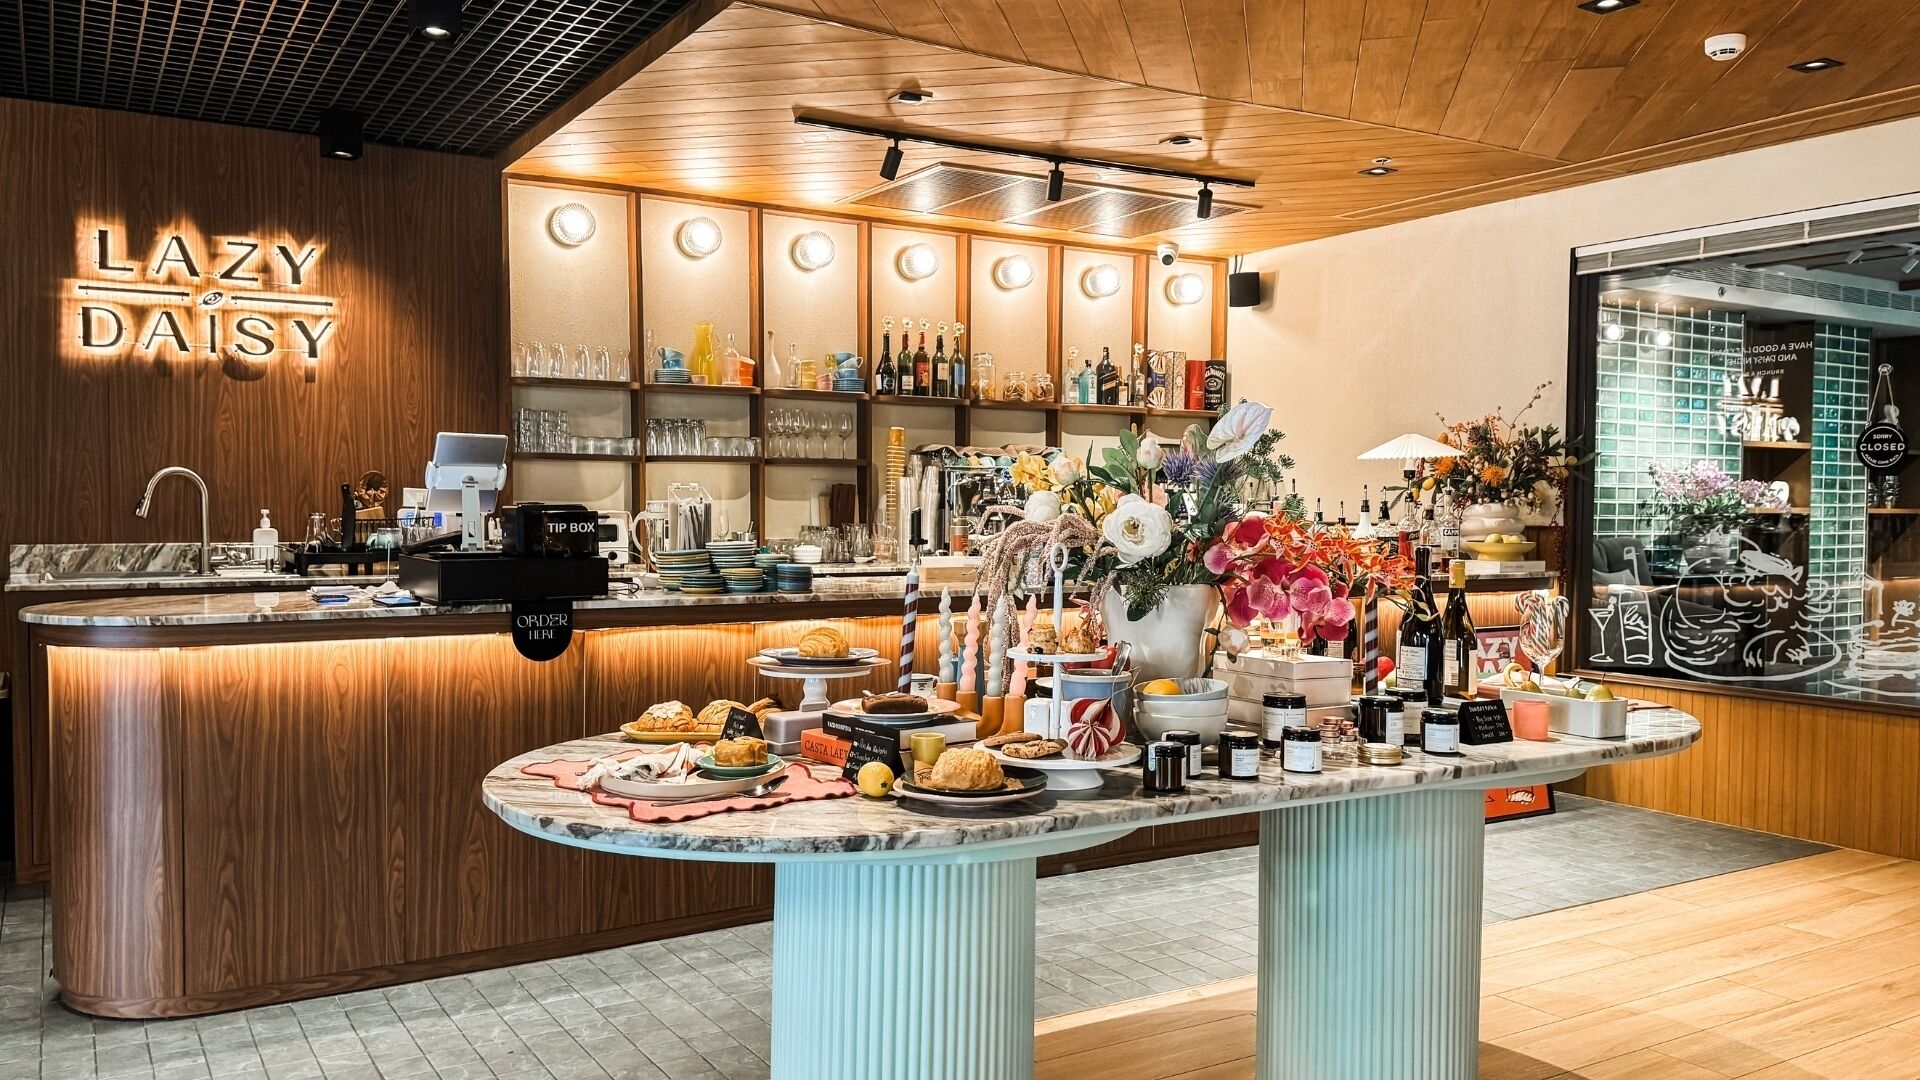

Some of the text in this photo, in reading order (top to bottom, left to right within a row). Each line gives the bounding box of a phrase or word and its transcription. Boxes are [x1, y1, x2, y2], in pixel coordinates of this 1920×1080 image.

[98, 229, 316, 285] LAZY
[81, 306, 332, 358] DAISY
[1860, 443, 1905, 451] CLOSED
[547, 522, 596, 533] TIP BOX
[516, 613, 568, 628] ORDER
[529, 629, 557, 640] HERE
[1476, 635, 1519, 659] AZY
[804, 740, 829, 756] CASTA
